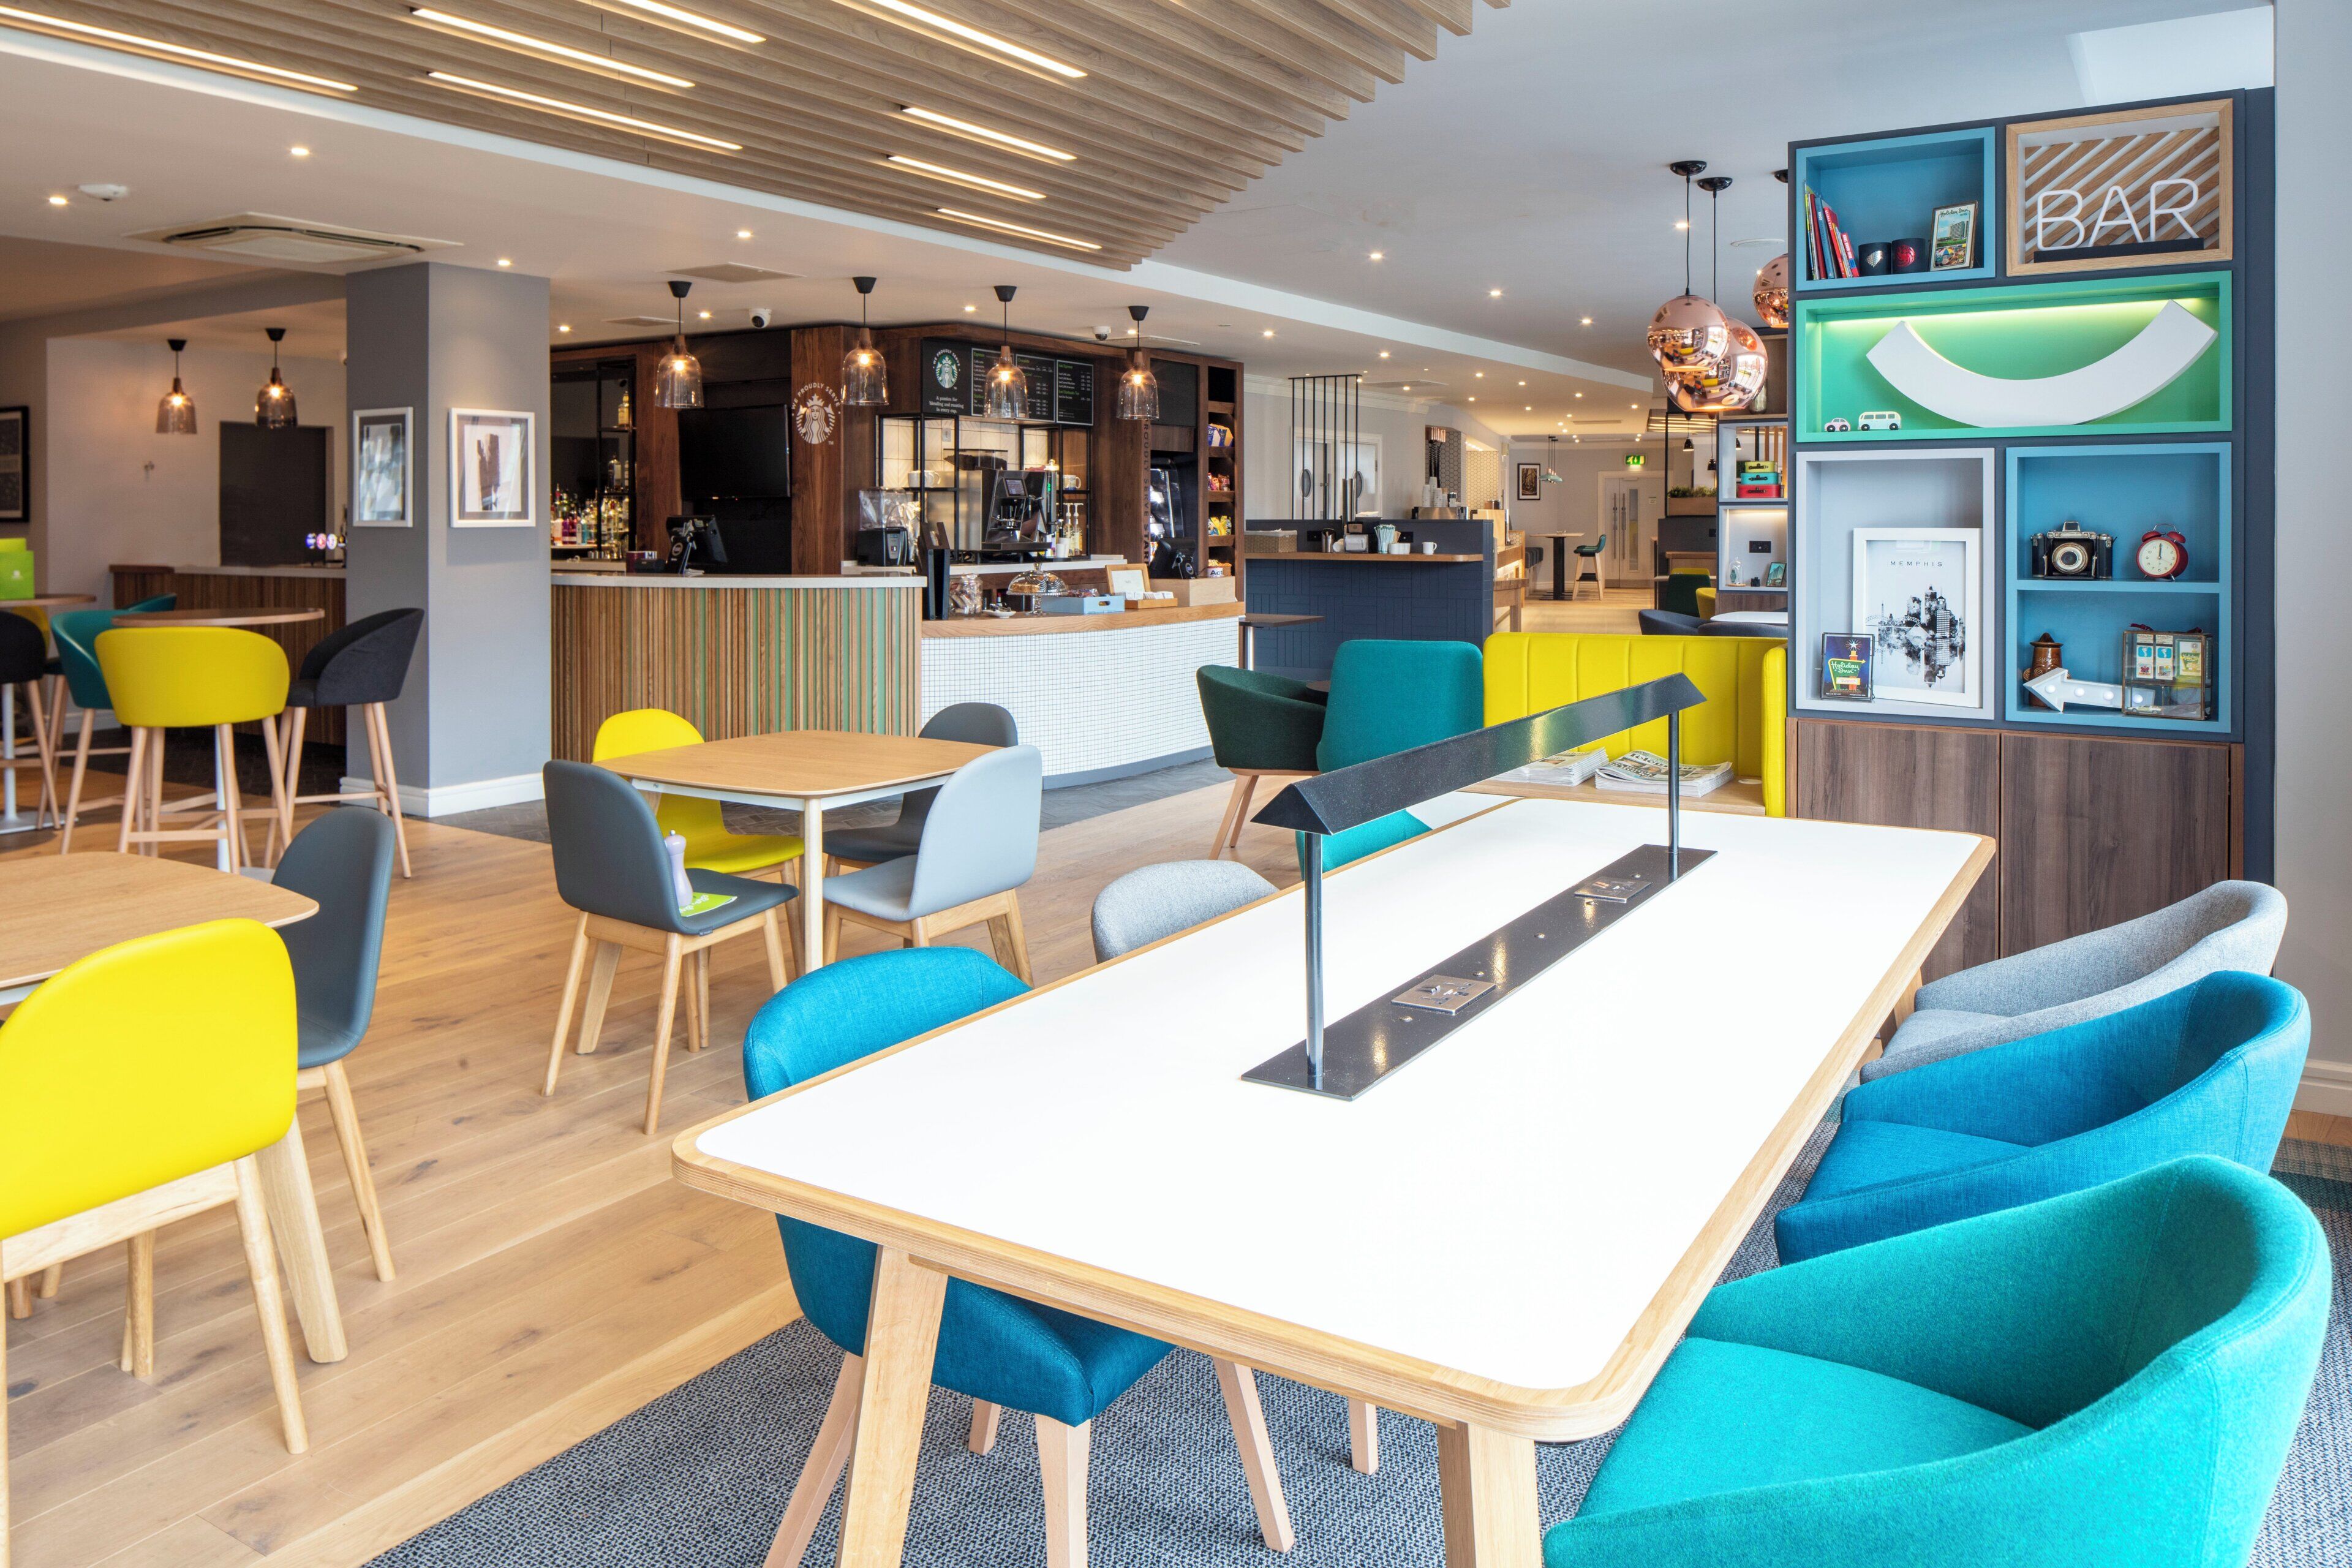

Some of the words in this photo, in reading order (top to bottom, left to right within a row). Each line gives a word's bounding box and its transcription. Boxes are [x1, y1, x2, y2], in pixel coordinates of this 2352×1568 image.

[2037, 178, 2199, 251] BAR
[952, 352, 960, 366] SERVE
[791, 398, 799, 410] WE
[797, 382, 824, 398] PROUDLY
[825, 386, 840, 407] SERVE
[1831, 662, 1860, 670] Holiday
